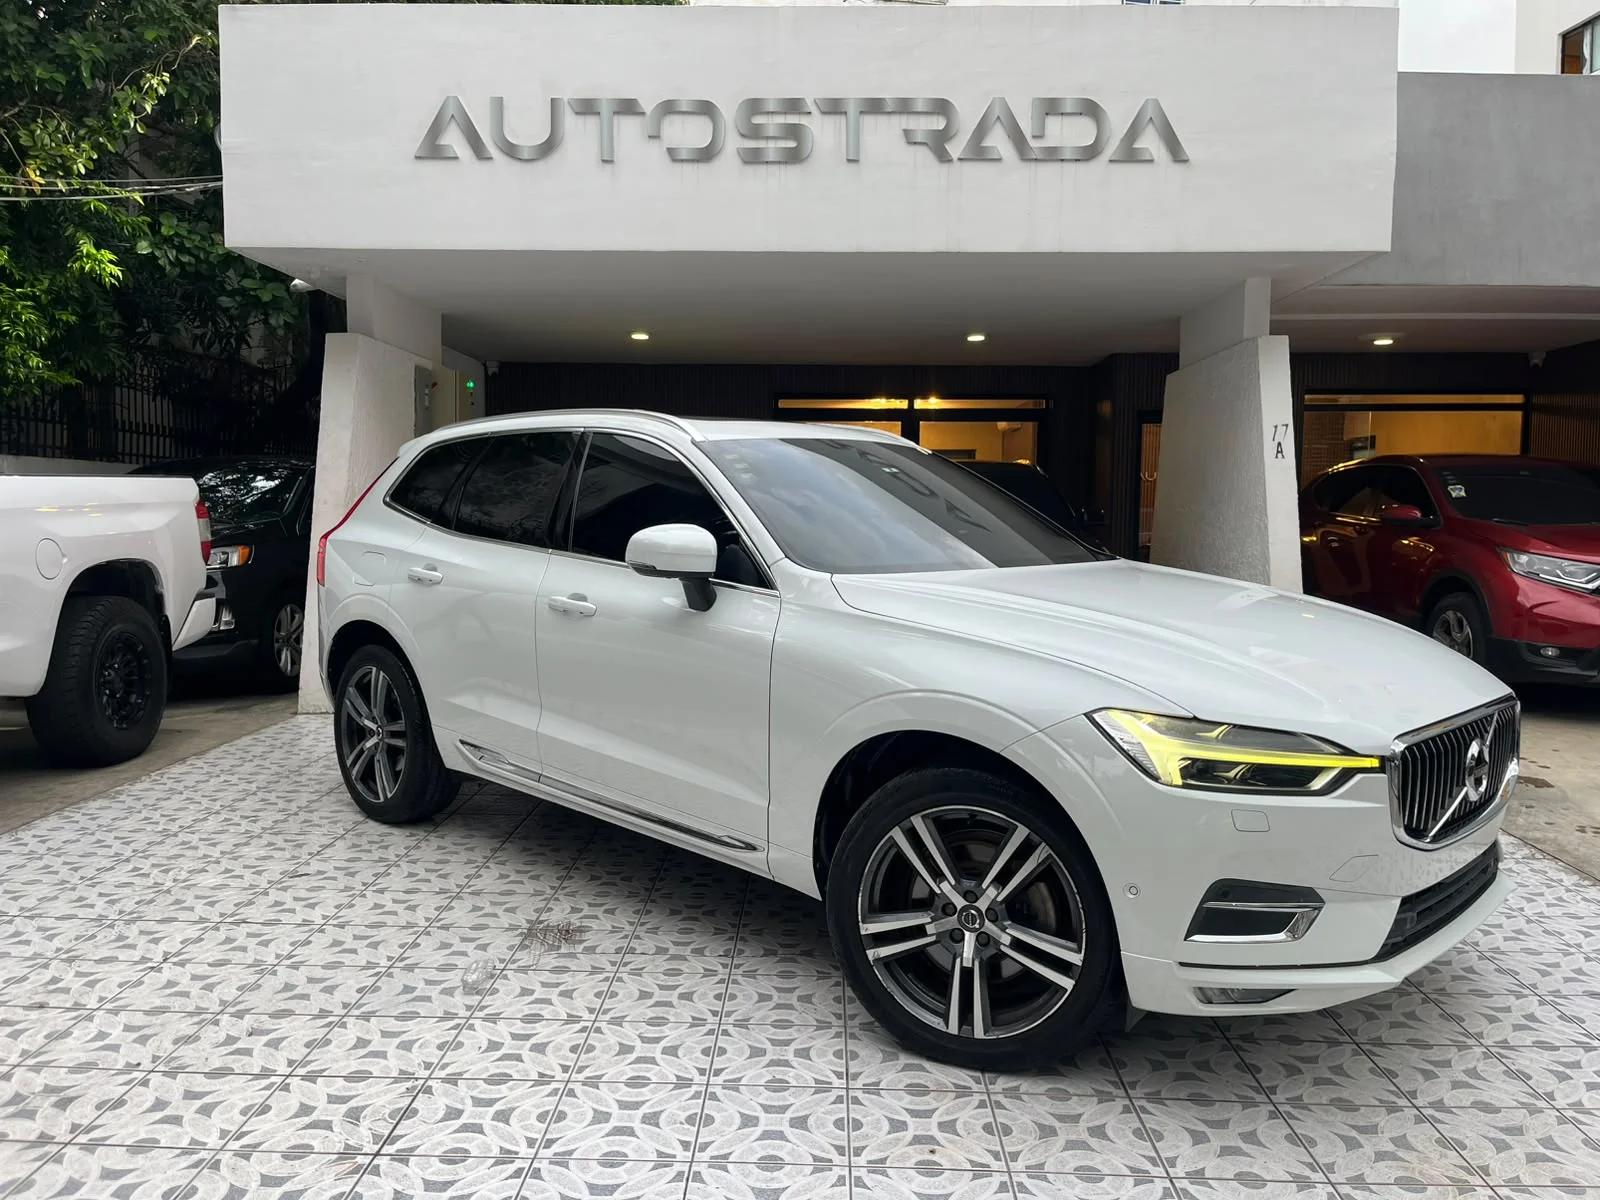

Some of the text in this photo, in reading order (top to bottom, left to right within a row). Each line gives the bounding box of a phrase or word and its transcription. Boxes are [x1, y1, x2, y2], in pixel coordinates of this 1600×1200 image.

[414, 95, 1190, 163] AUTOSTRADA
[1272, 423, 1289, 441] 17
[1274, 441, 1286, 459] A
